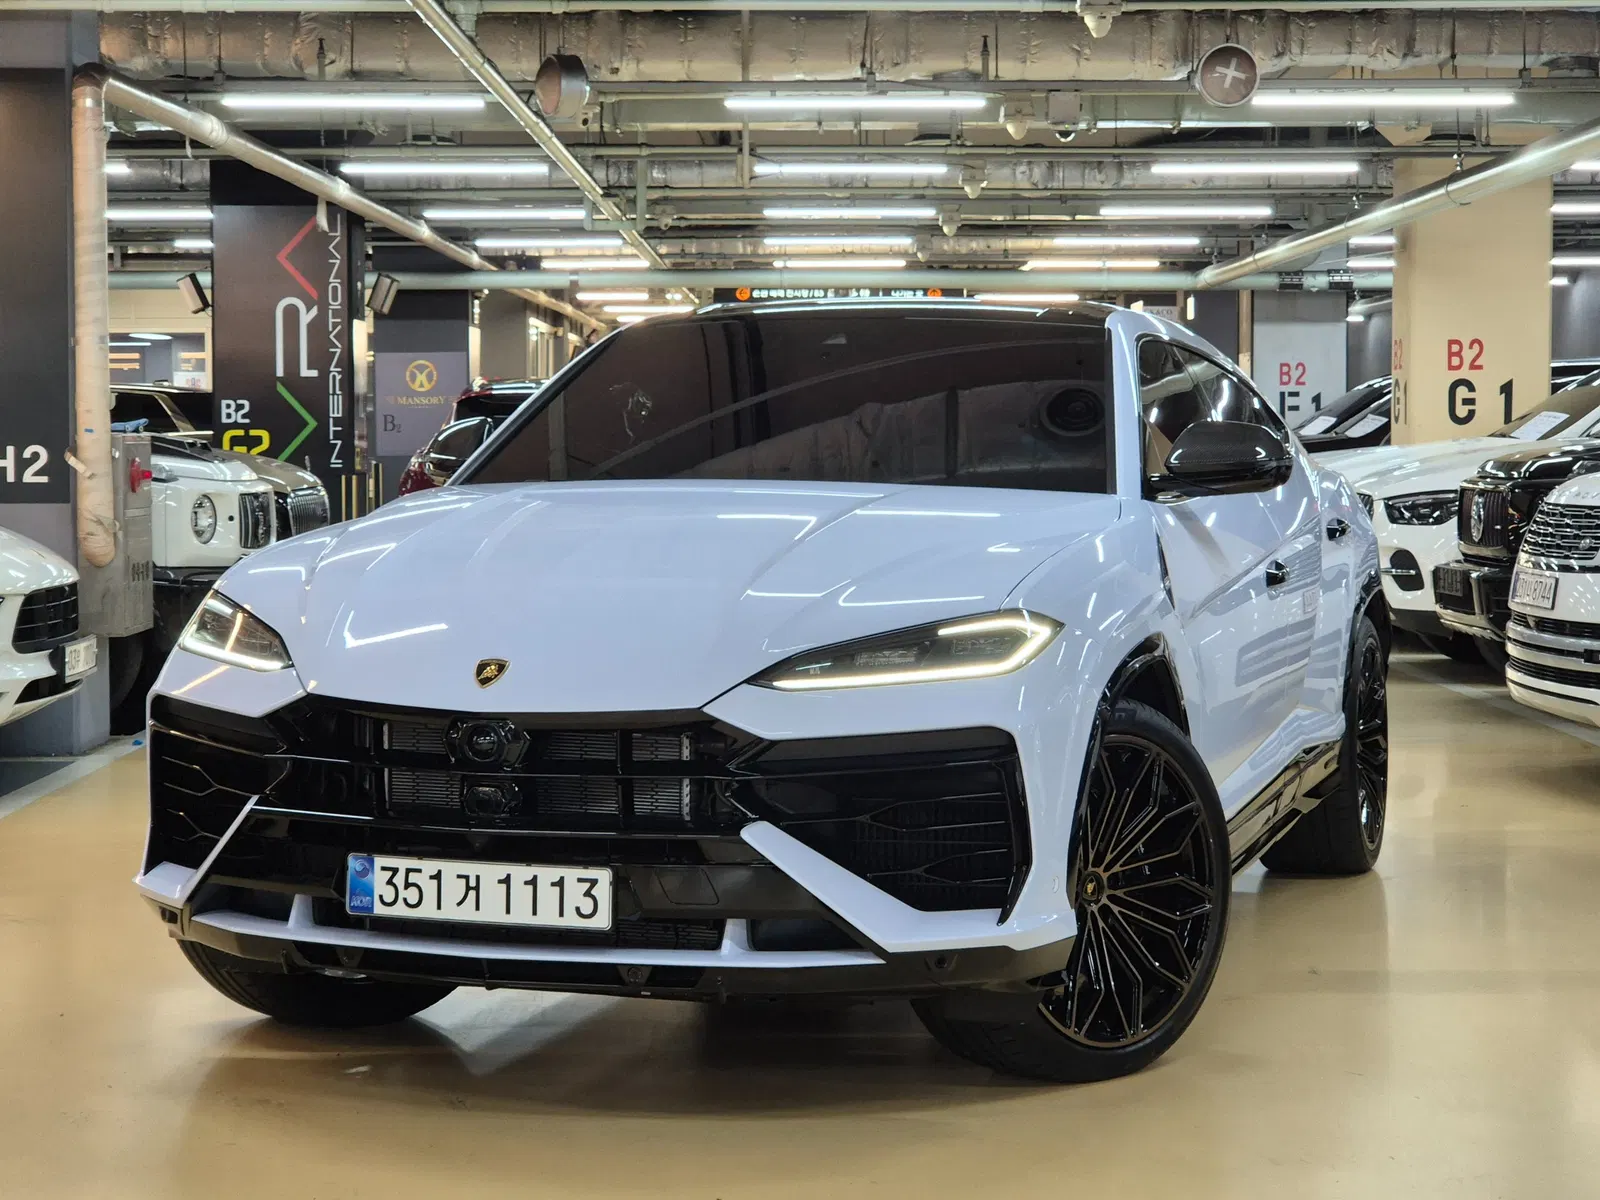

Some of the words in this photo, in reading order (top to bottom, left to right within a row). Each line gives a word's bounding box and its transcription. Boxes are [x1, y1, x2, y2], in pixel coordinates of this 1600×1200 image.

[328, 213, 343, 468] INTERNATIONAL
[1448, 338, 1484, 371] B2
[1279, 362, 1306, 386] B2
[221, 399, 250, 423] B2
[397, 396, 444, 405] MANSORY
[350, 896, 372, 908] KOR
[378, 866, 480, 912] 351거
[497, 873, 599, 919] 1113
